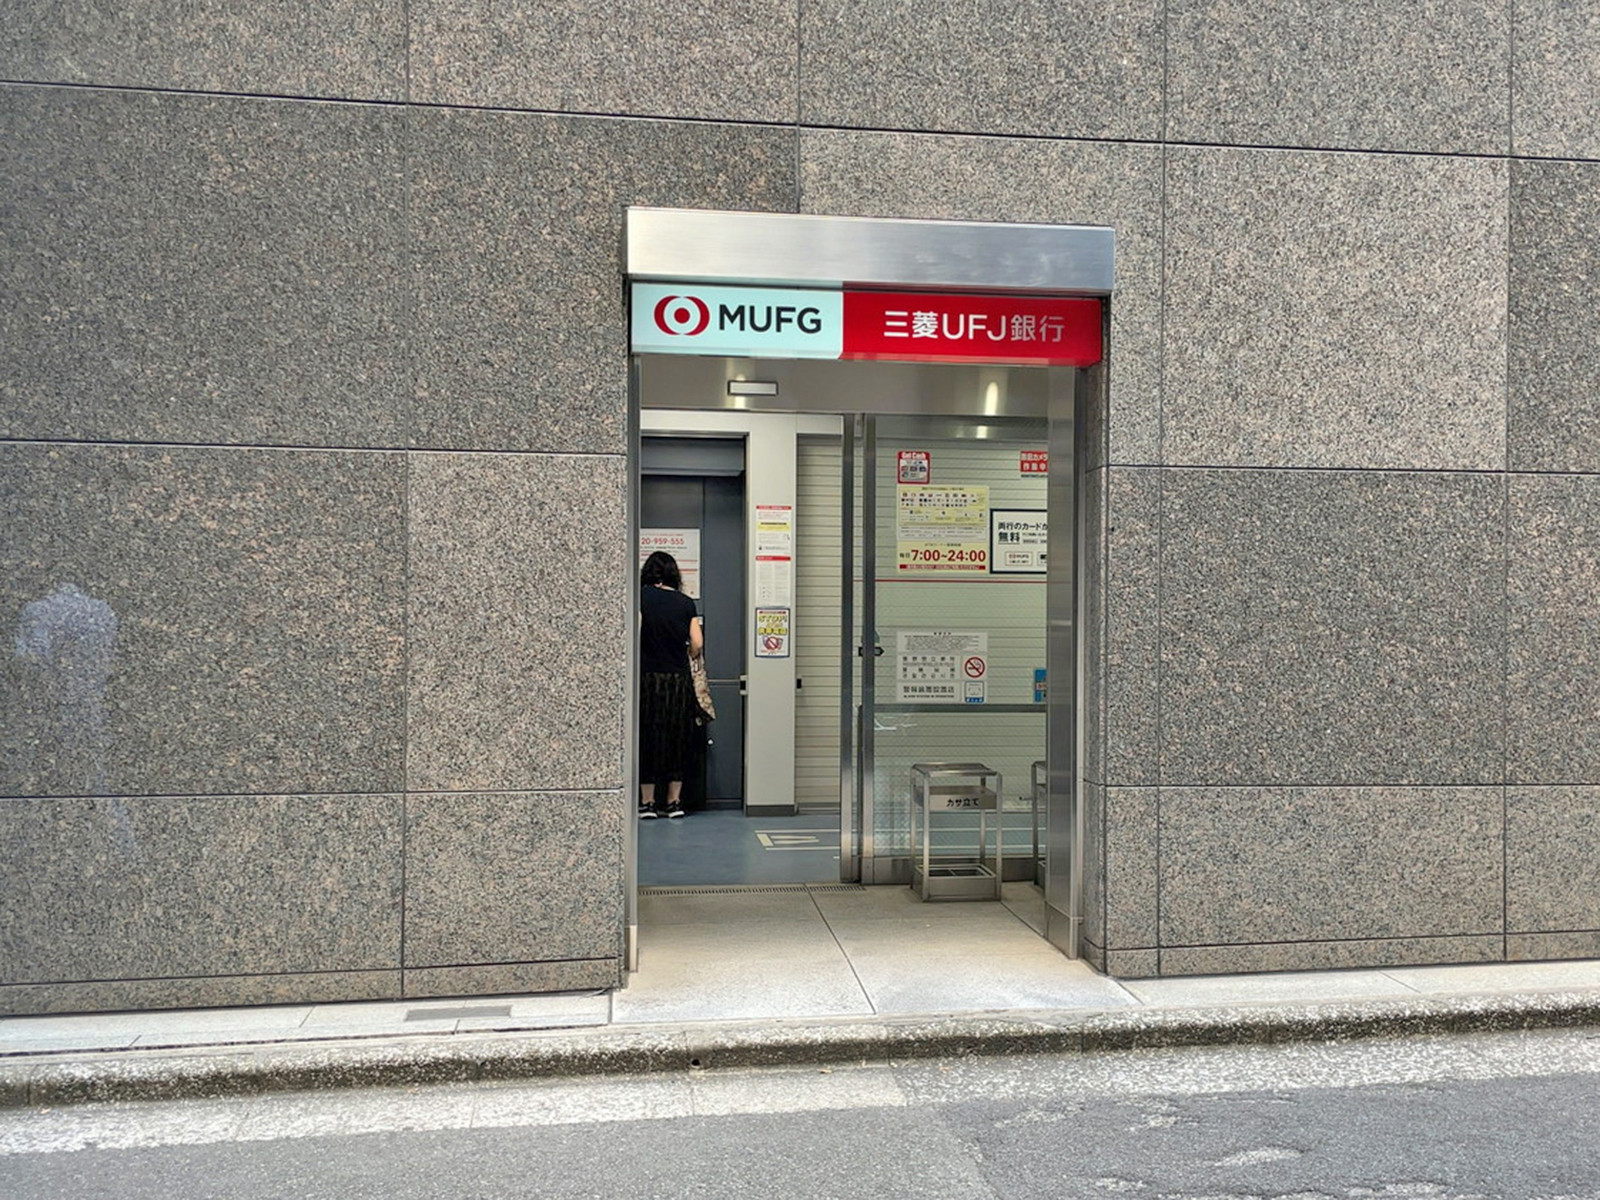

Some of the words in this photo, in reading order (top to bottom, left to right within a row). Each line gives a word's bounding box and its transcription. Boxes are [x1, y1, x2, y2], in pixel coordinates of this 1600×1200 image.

[718, 304, 822, 334] MUFG
[883, 310, 1066, 343] 三菱UFJ銀行
[998, 532, 1020, 542] 無料
[946, 798, 979, 807] カサ立て
